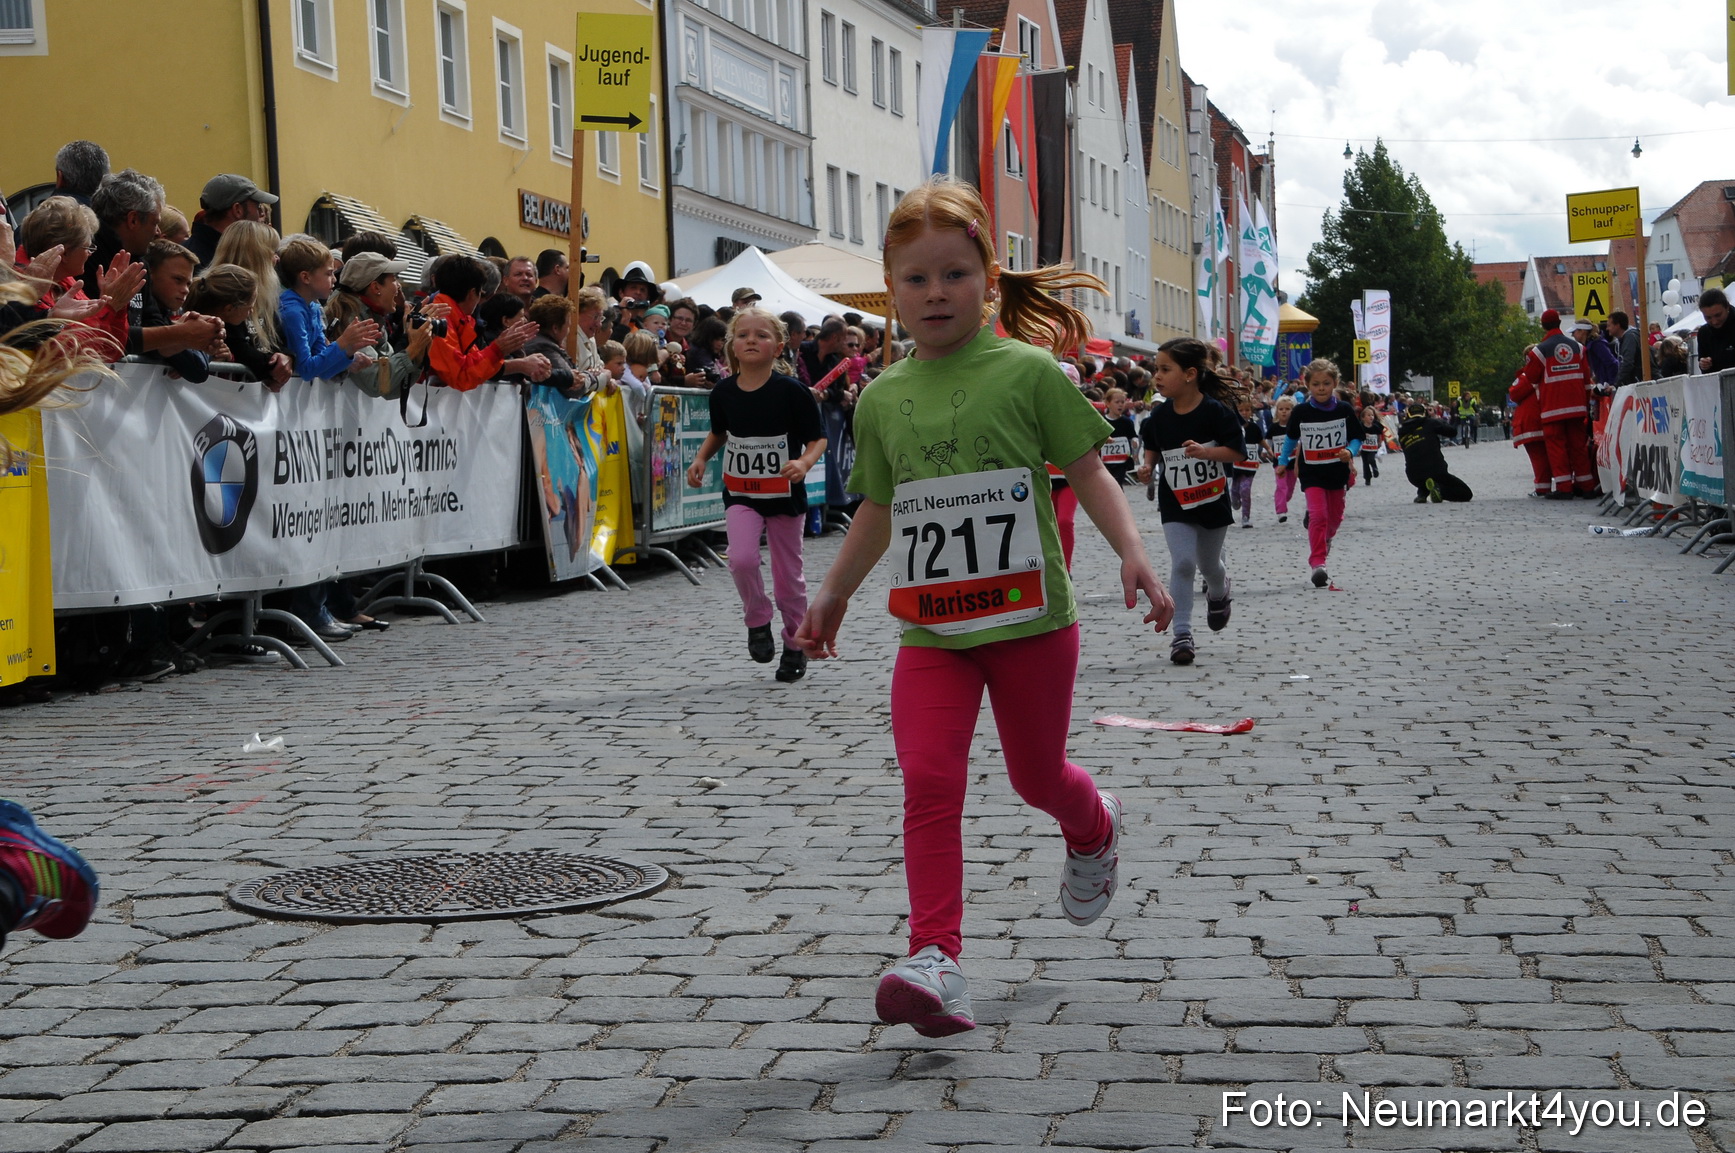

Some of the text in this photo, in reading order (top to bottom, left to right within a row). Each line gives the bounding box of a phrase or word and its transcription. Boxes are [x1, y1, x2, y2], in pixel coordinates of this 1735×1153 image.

[579, 44, 650, 67] Jugend-
[598, 68, 631, 86] lauf
[523, 193, 589, 240] BELACCAO
[1571, 203, 1634, 217] Schnupper-
[1593, 217, 1614, 229] lauf
[1577, 274, 1608, 286] Block
[1583, 289, 1606, 316] A
[1358, 347, 1367, 359] B
[194, 415, 257, 461] BMW
[1104, 444, 1126, 455] 7221
[1306, 431, 1342, 449] 7212
[273, 427, 458, 485] BMW EfficientDynamics
[727, 450, 780, 475] 7049
[1169, 461, 1218, 488] 7193
[893, 488, 1004, 517] PARTL Neumarkt
[1183, 487, 1213, 501] Selina
[272, 501, 324, 544] Weniger
[381, 489, 407, 523] Mehr
[902, 513, 1016, 582] 7217
[918, 588, 1004, 619] Marissa
